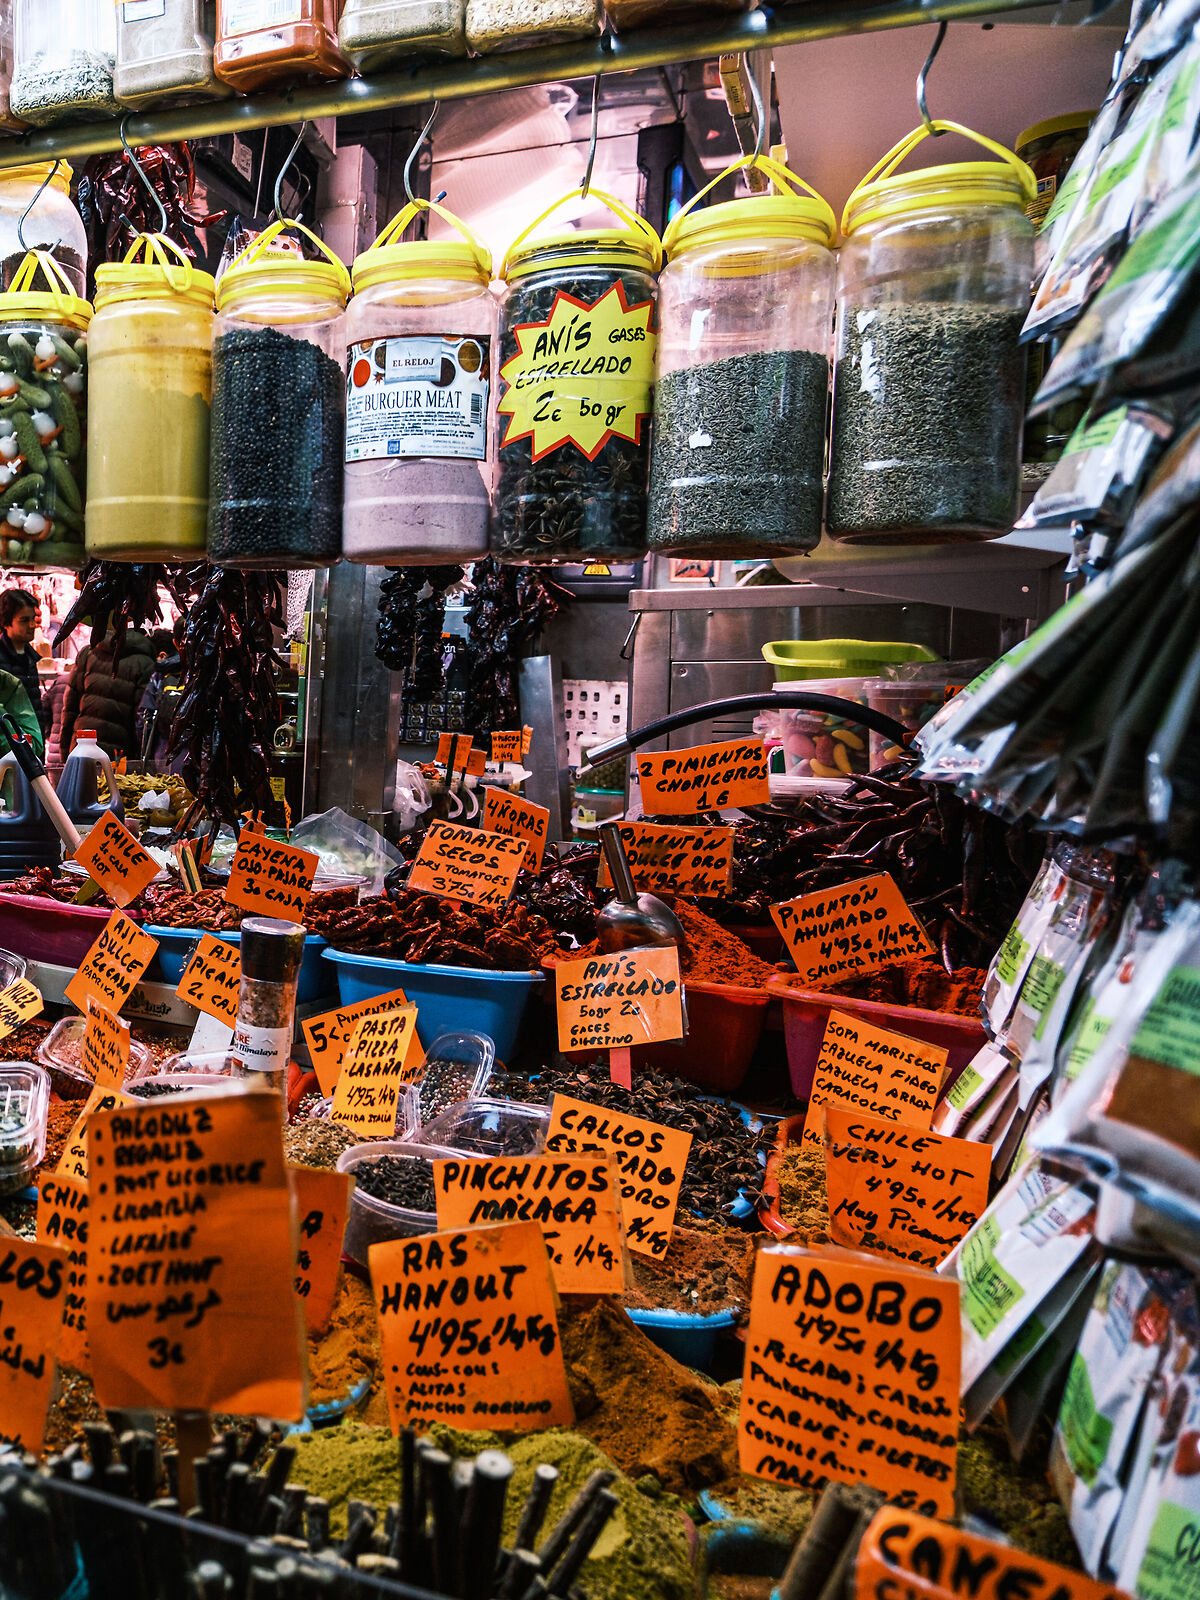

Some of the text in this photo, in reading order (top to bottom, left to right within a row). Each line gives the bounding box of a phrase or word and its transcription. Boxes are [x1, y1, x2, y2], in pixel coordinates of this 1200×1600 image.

[533, 313, 647, 361] ANÍS GASES
[392, 357, 435, 368] EL RELOJ
[515, 355, 632, 390] ESTRELLADO
[364, 388, 462, 413] BURGUER MEAT
[640, 745, 762, 777] 2 PIMIENTOS
[656, 763, 768, 792] CHORICEROS
[103, 822, 149, 866] CHILE
[428, 823, 527, 855] TOMATES
[91, 852, 111, 876] HOT
[237, 840, 306, 873] CAYENA
[416, 857, 510, 886] DRY TOMATOES
[435, 843, 500, 869] SECOS
[691, 854, 727, 869] ORO
[264, 888, 305, 913] CAJA
[793, 907, 888, 945] AHUMADO
[98, 929, 144, 973] DULCE
[806, 941, 927, 982] SMOKED PAPRIKA
[81, 964, 116, 1001] PAPRIKA
[583, 955, 637, 980] ANÍS
[560, 978, 677, 1001] ESTRELLADO
[211, 994, 238, 1018] CAJ
[358, 1016, 407, 1040] PASTA
[570, 1033, 634, 1048] DIGESTIVO
[826, 1020, 941, 1074] SOPA MARISCOS
[349, 1057, 402, 1078] LASAÑA
[890, 1069, 938, 1095] FIDEO
[815, 1077, 902, 1121] CARACOLES
[331, 1110, 365, 1122] COMIDA
[559, 1109, 665, 1153] CALLOS
[847, 1124, 943, 1152] CHILE
[442, 1161, 609, 1194] PINCHITOS
[832, 1142, 975, 1187] VERY HOT
[833, 1197, 879, 1231] Muy
[402, 1233, 469, 1278] RAS
[379, 1264, 528, 1316] HANOUT
[771, 1263, 943, 1333] ADOBO
